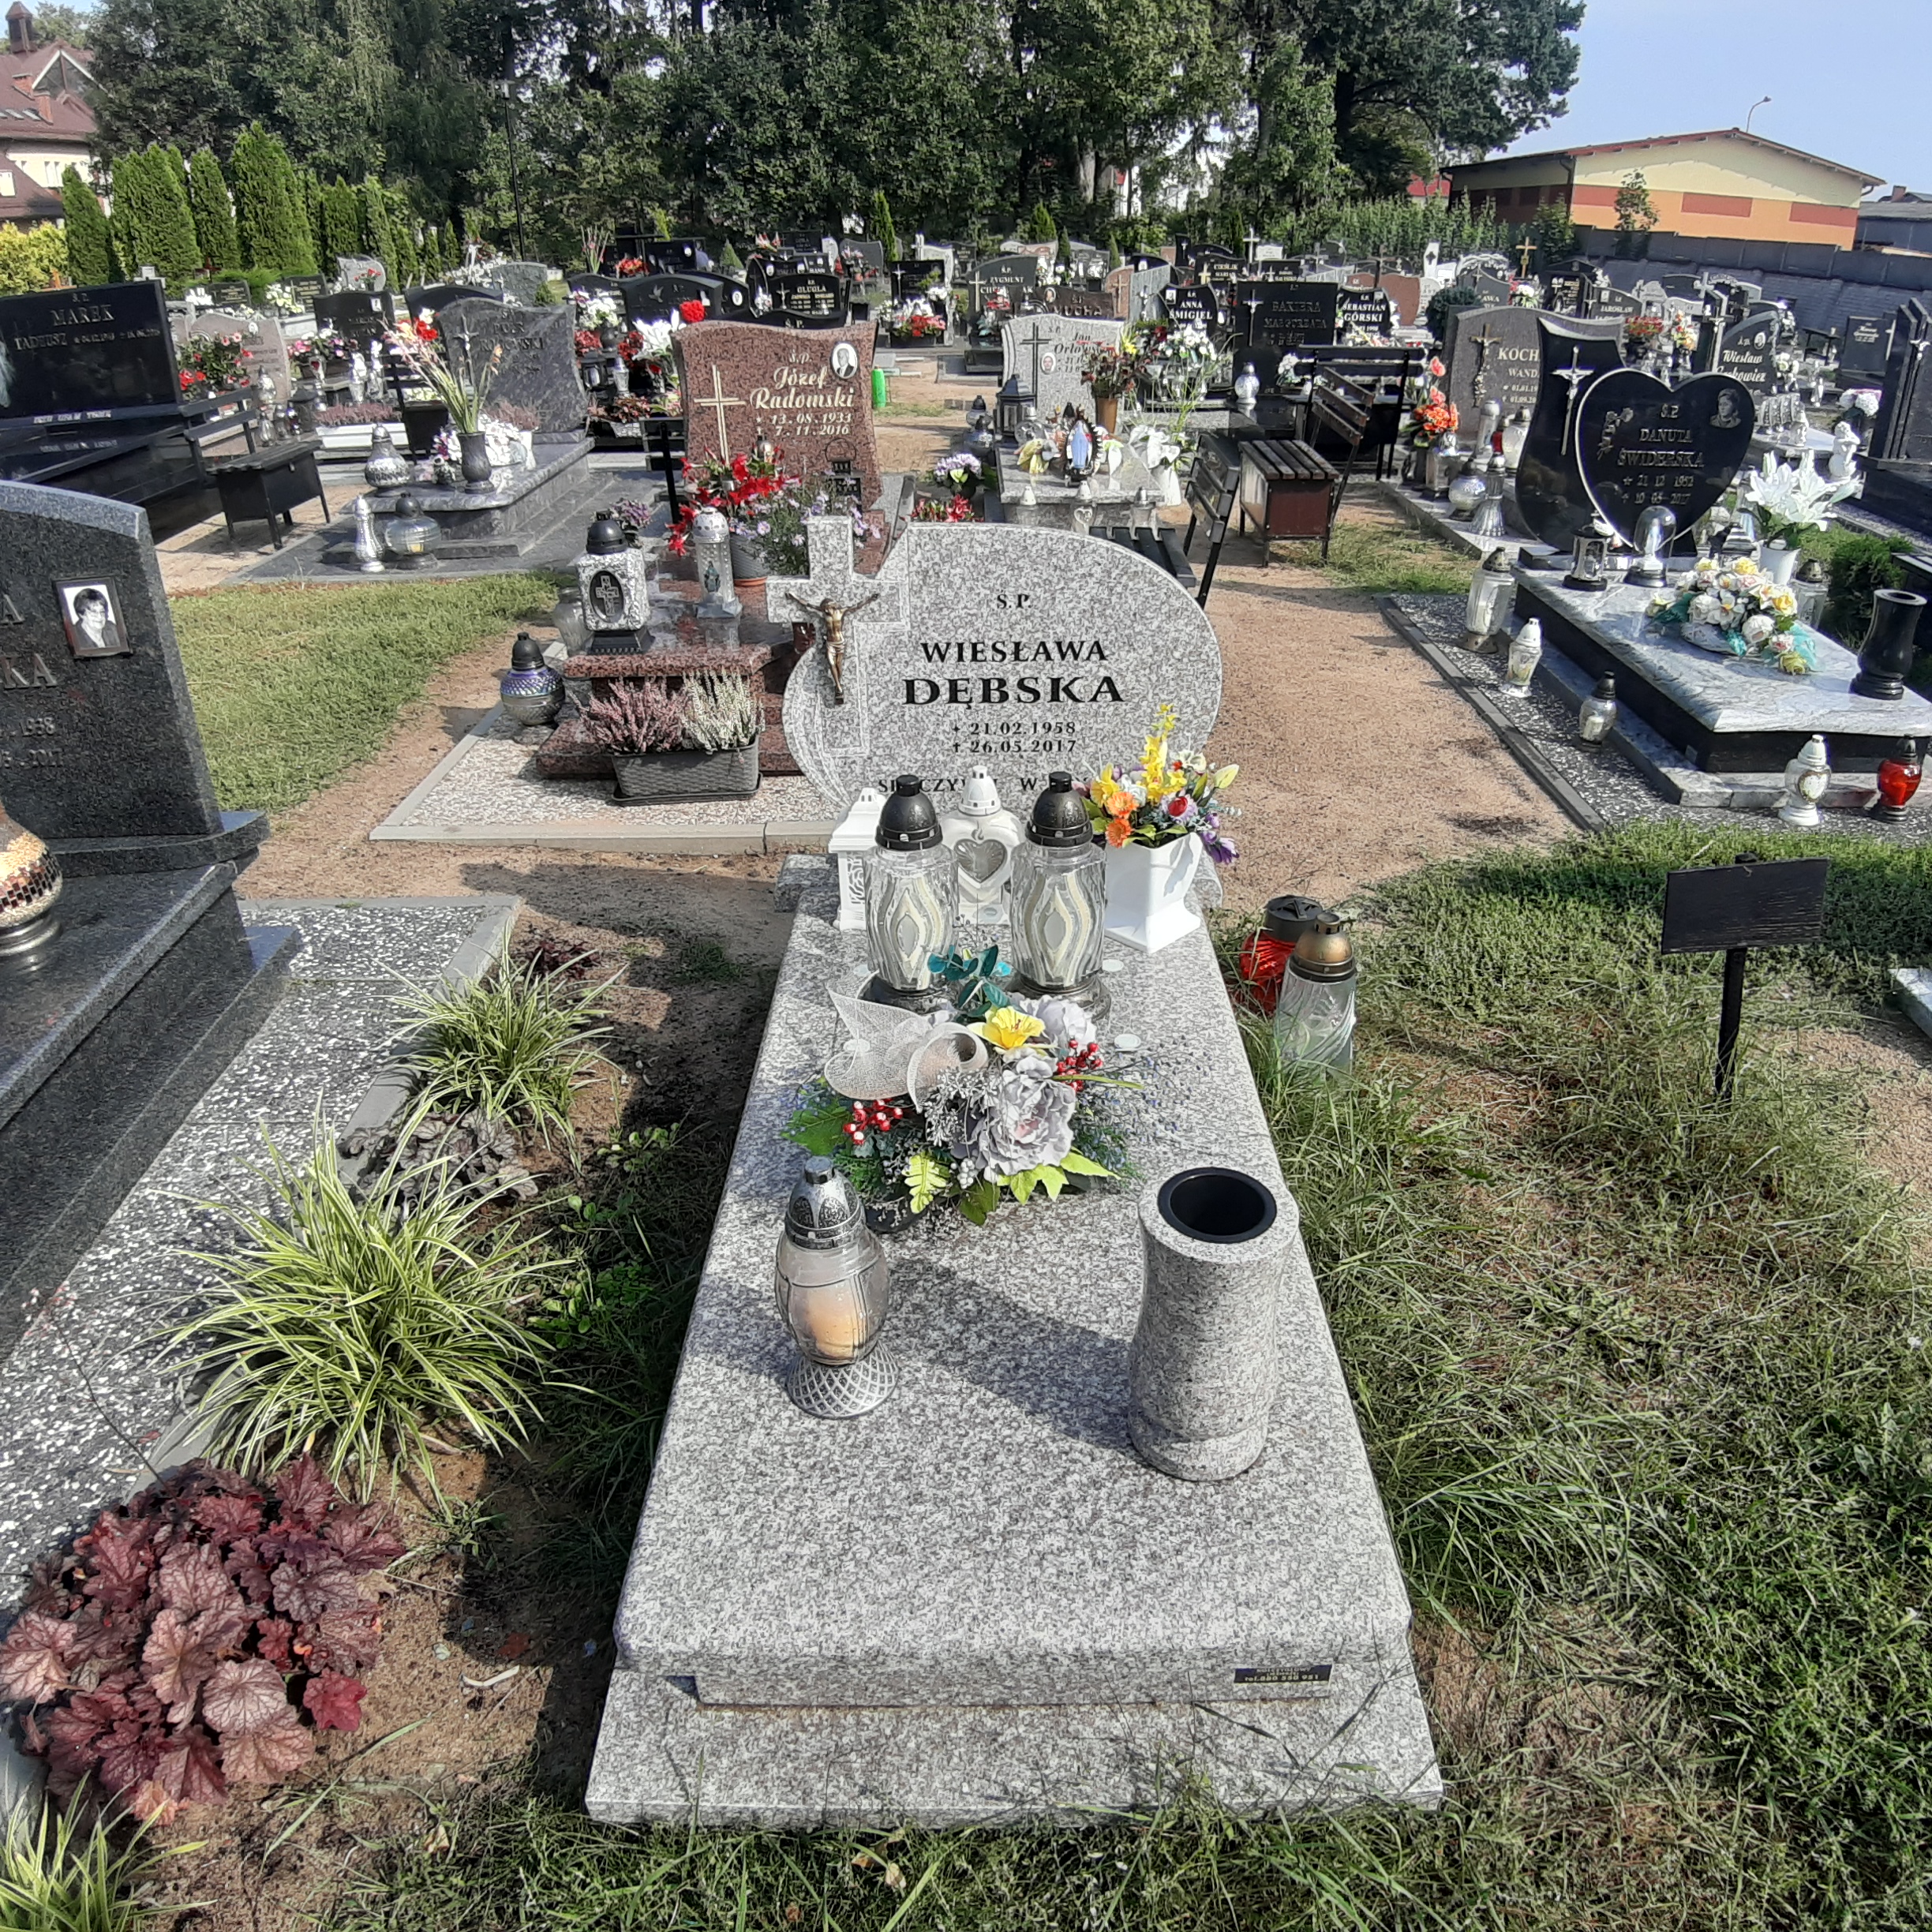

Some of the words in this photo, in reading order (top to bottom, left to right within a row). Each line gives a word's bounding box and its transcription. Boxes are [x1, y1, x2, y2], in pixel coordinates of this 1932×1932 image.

[50, 304, 114, 327] MAREK
[1169, 309, 1213, 320] ŚMIGIEL
[1342, 303, 1387, 312] SEBASTIAN
[1344, 311, 1383, 323] GÓRSKI
[14, 332, 69, 350] TADEUSZ
[773, 365, 828, 390] Józef
[750, 386, 854, 410] Radomski
[1639, 429, 1694, 443] DANUTA
[920, 640, 1108, 663] WIESŁAWA
[902, 676, 1125, 710] DĘBSKA
[970, 721, 1076, 736] 21.02.1958
[970, 739, 1076, 753] 26.05.2017
